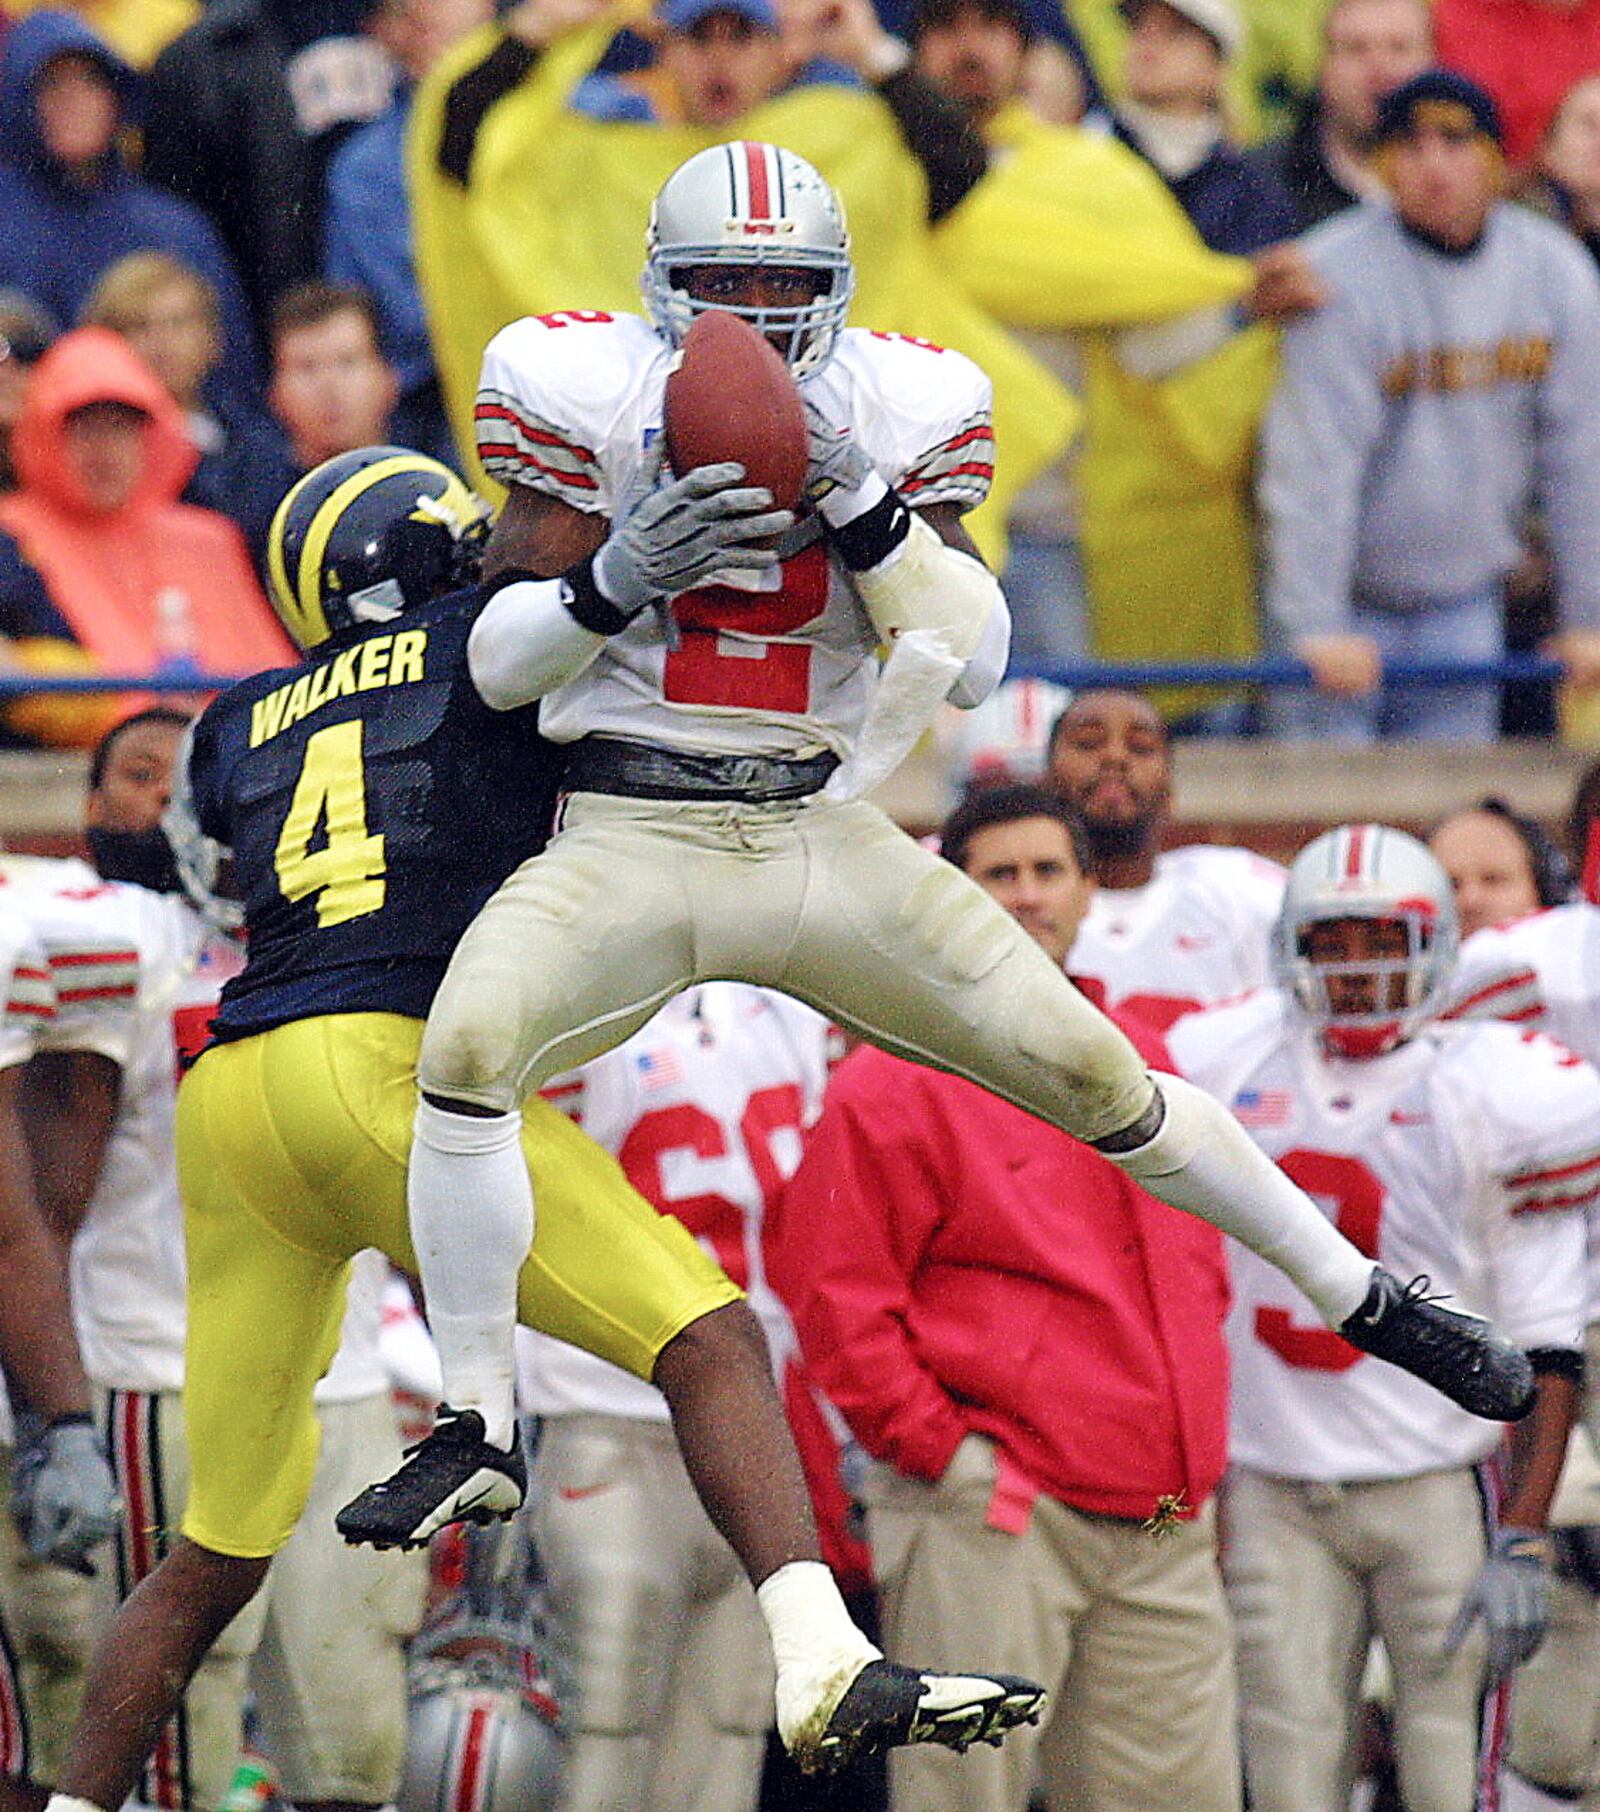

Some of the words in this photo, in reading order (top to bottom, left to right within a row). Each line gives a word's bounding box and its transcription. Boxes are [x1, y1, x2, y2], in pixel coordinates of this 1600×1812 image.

[249, 629, 428, 748] WALKER
[664, 538, 830, 714] 2
[274, 719, 387, 928] 4
